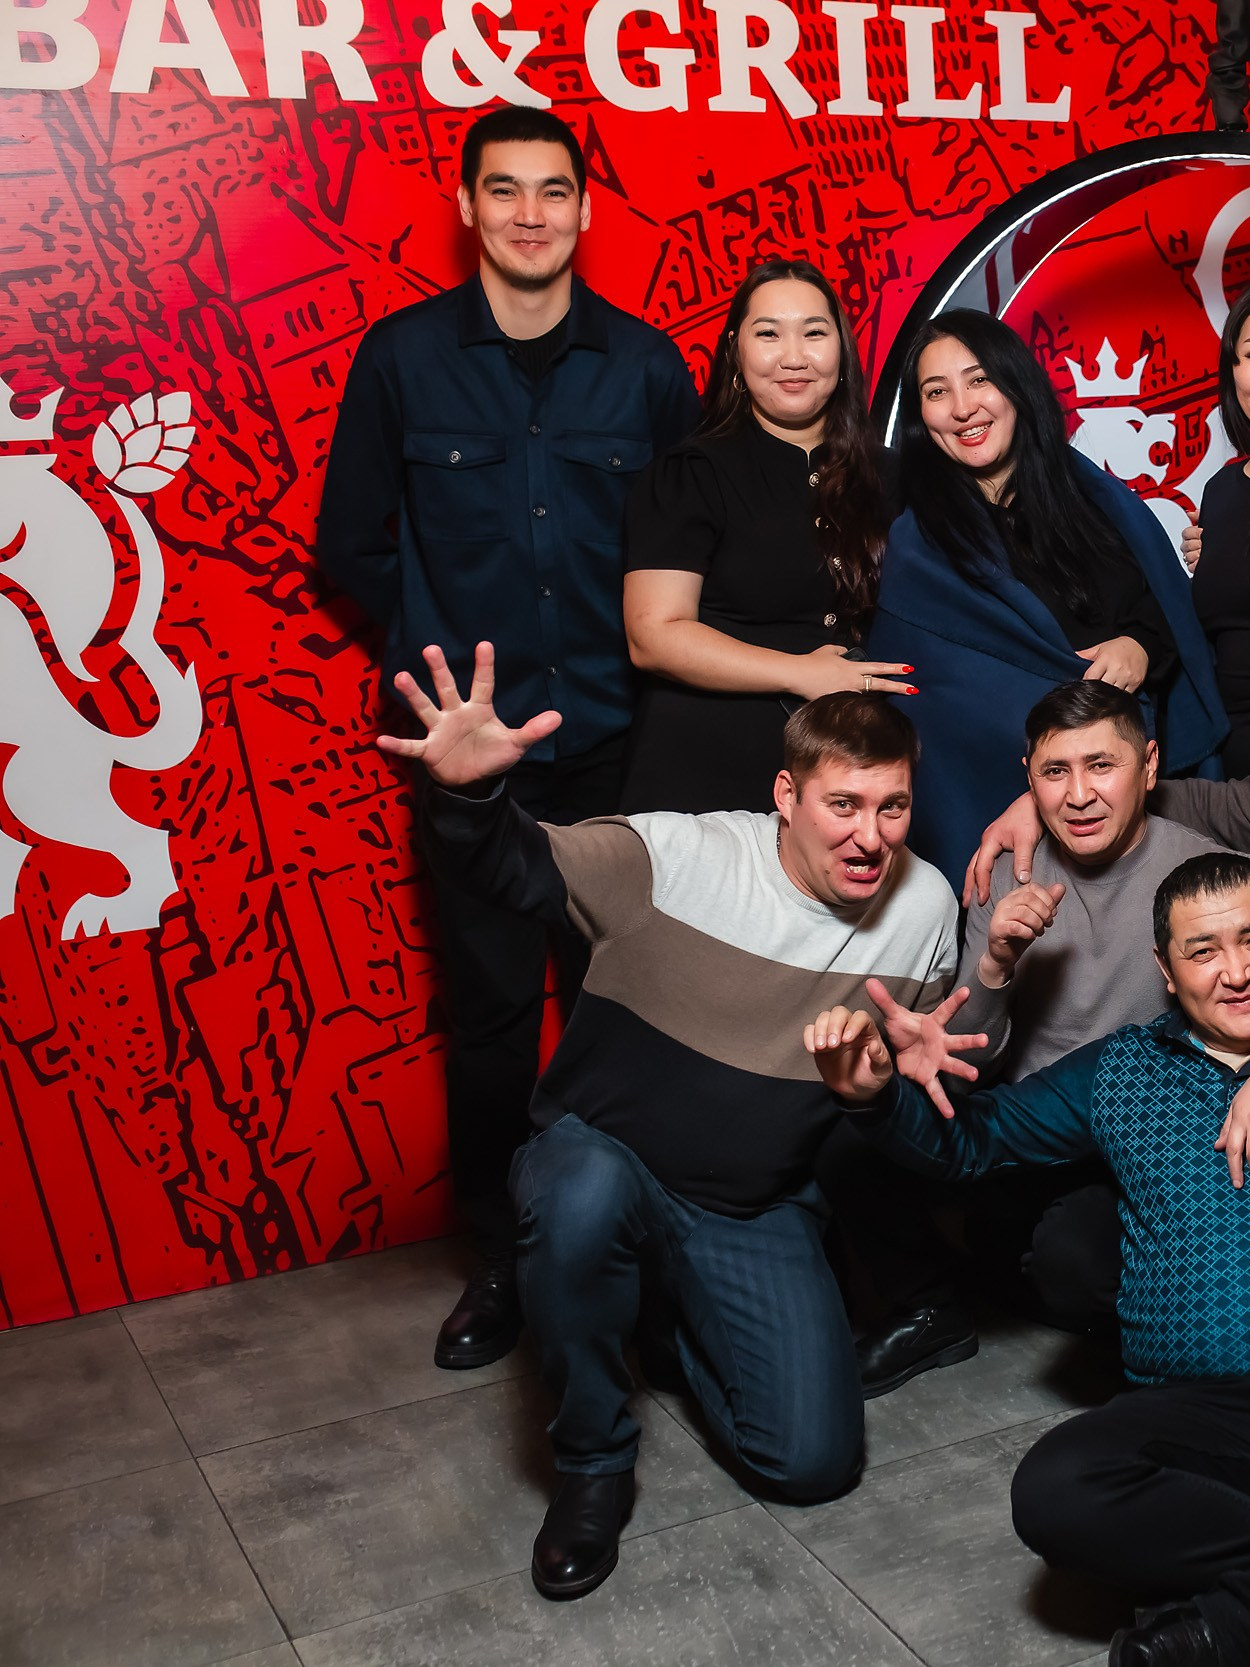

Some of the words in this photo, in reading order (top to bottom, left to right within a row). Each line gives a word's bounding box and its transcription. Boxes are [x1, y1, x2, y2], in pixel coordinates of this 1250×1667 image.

[0, 0, 378, 102] BAR
[421, 0, 552, 109] &
[584, 0, 1072, 122] GRILL
